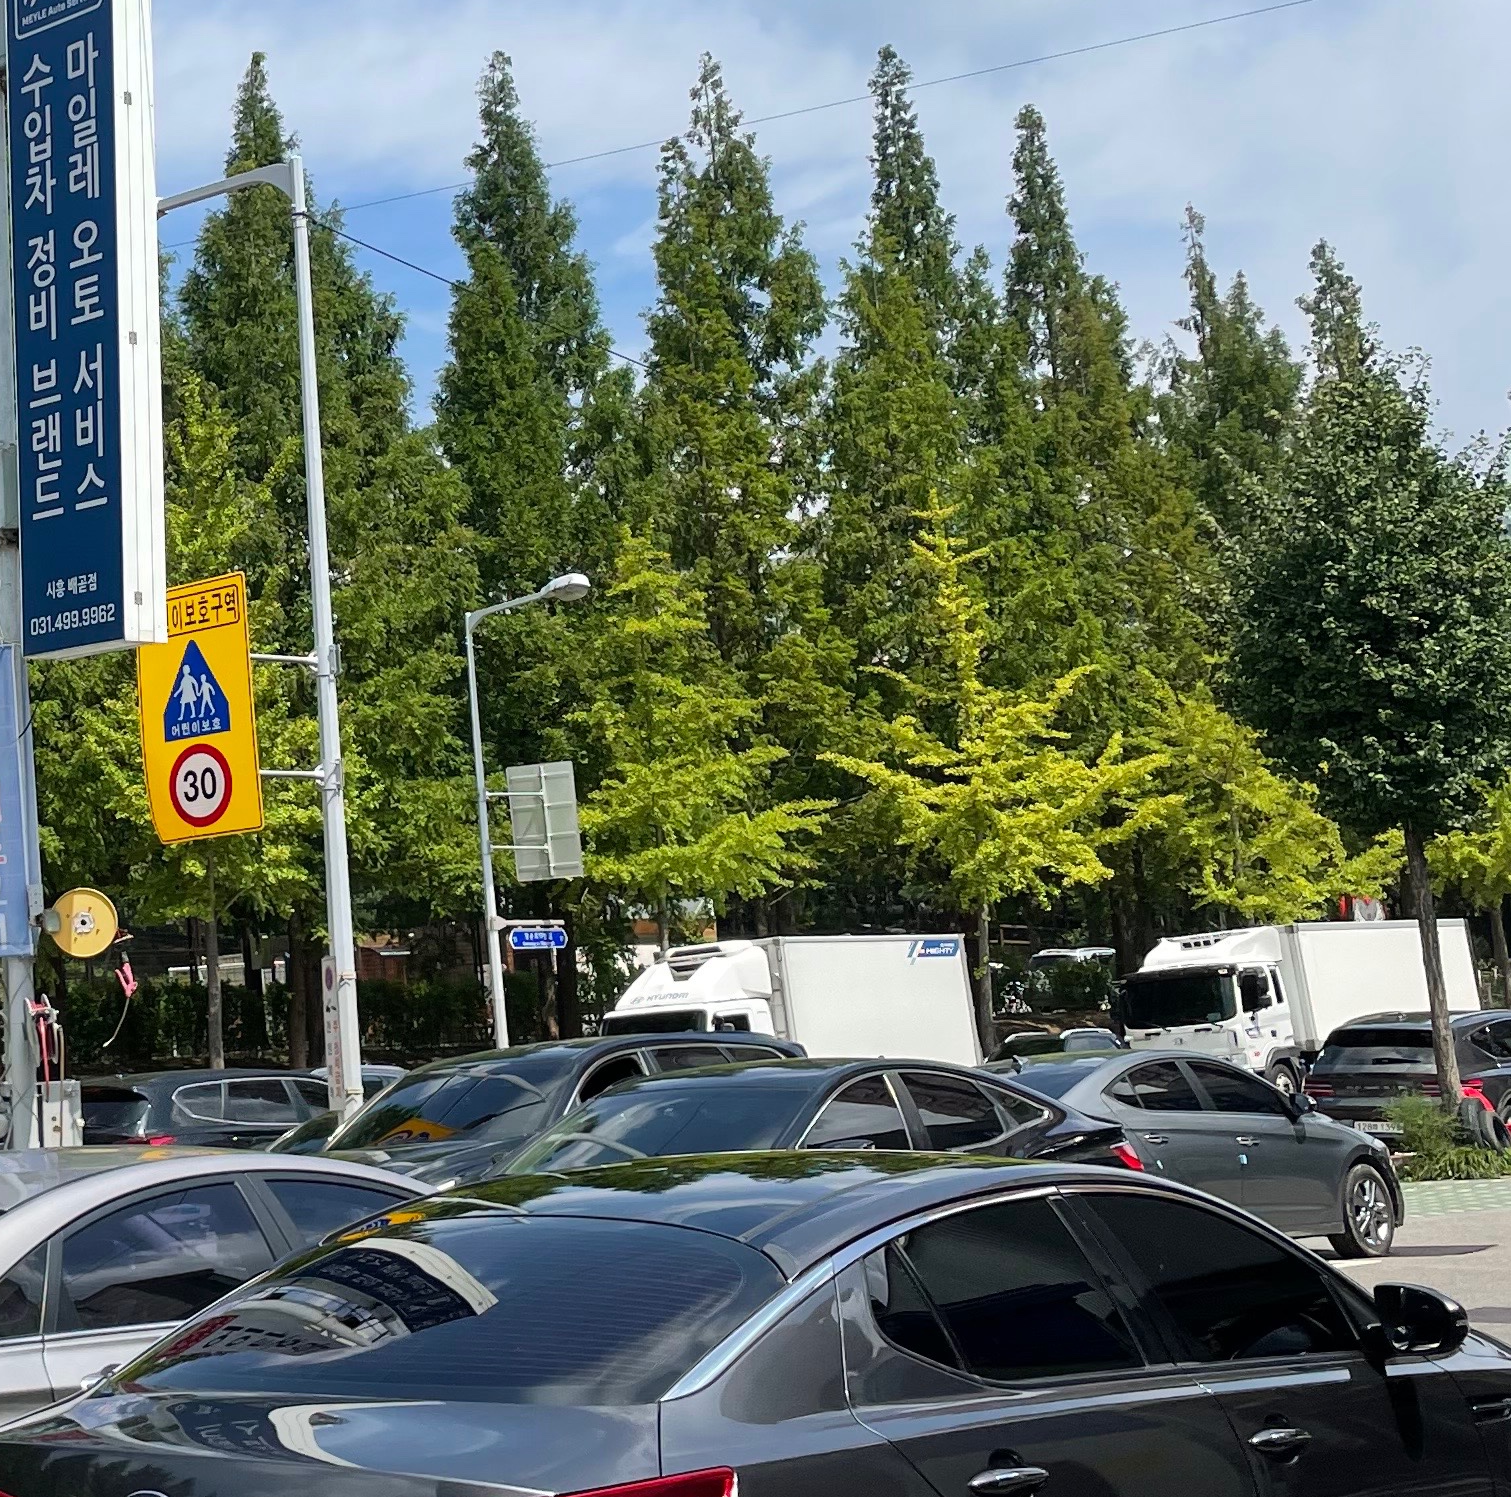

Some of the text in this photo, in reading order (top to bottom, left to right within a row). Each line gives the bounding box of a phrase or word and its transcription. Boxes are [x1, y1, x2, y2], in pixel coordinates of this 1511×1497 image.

[21, 8, 47, 26] MEYLE
[48, 1, 66, 17] Auto
[20, 53, 64, 521] 수입차 정비 브랜드
[66, 32, 108, 511] 마일레 오토 서비스
[46, 572, 97, 599] 시흥 배곧점
[30, 603, 116, 636] 031.499.9962
[168, 588, 238, 632] 이보호구역
[171, 717, 222, 737] 어린이보호
[183, 767, 217, 803] 30
